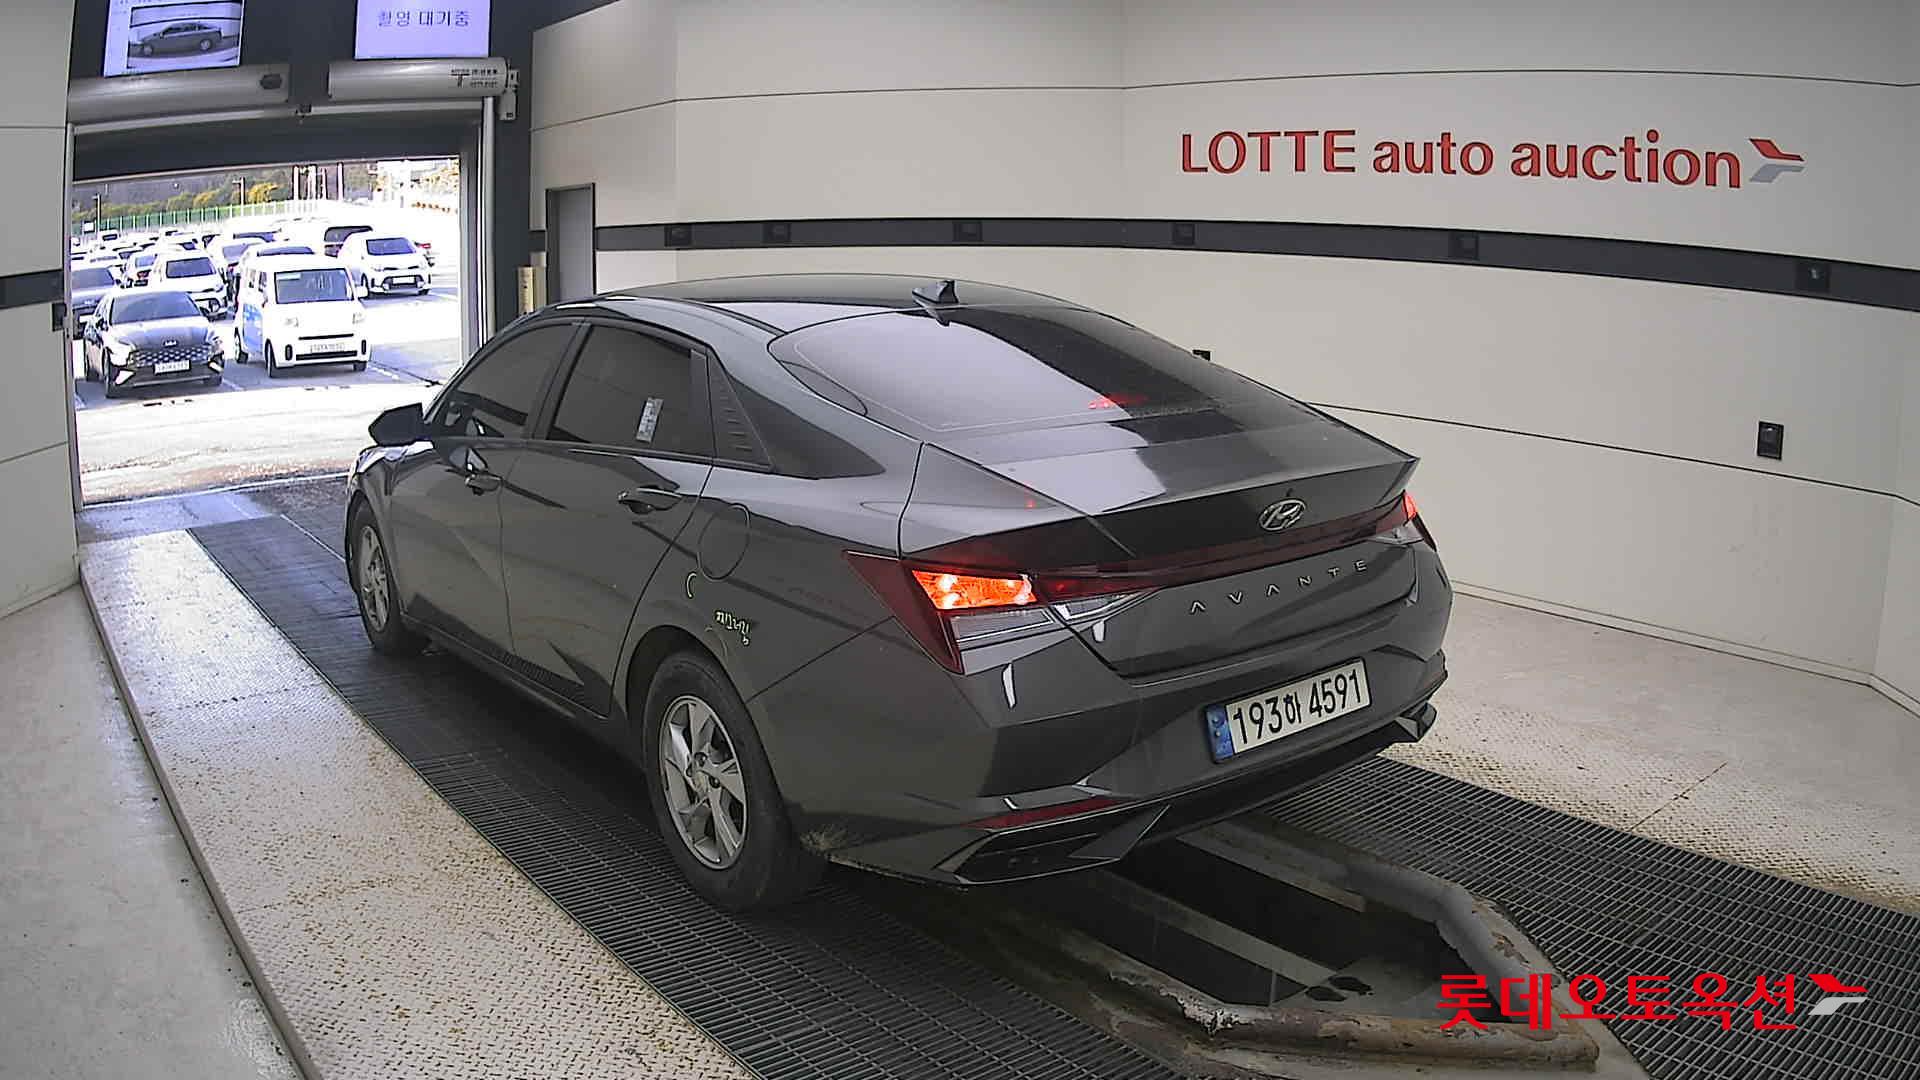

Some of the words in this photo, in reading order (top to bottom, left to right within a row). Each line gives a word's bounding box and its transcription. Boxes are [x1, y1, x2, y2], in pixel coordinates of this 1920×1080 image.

[418, 8, 470, 28] 대기중
[1182, 130, 1356, 174] LOTTE
[1374, 132, 1495, 177] auto
[1511, 130, 1741, 188] auction
[1190, 559, 1368, 615] AVANTE
[1232, 691, 1302, 744] 193하
[1309, 668, 1362, 720] 4591
